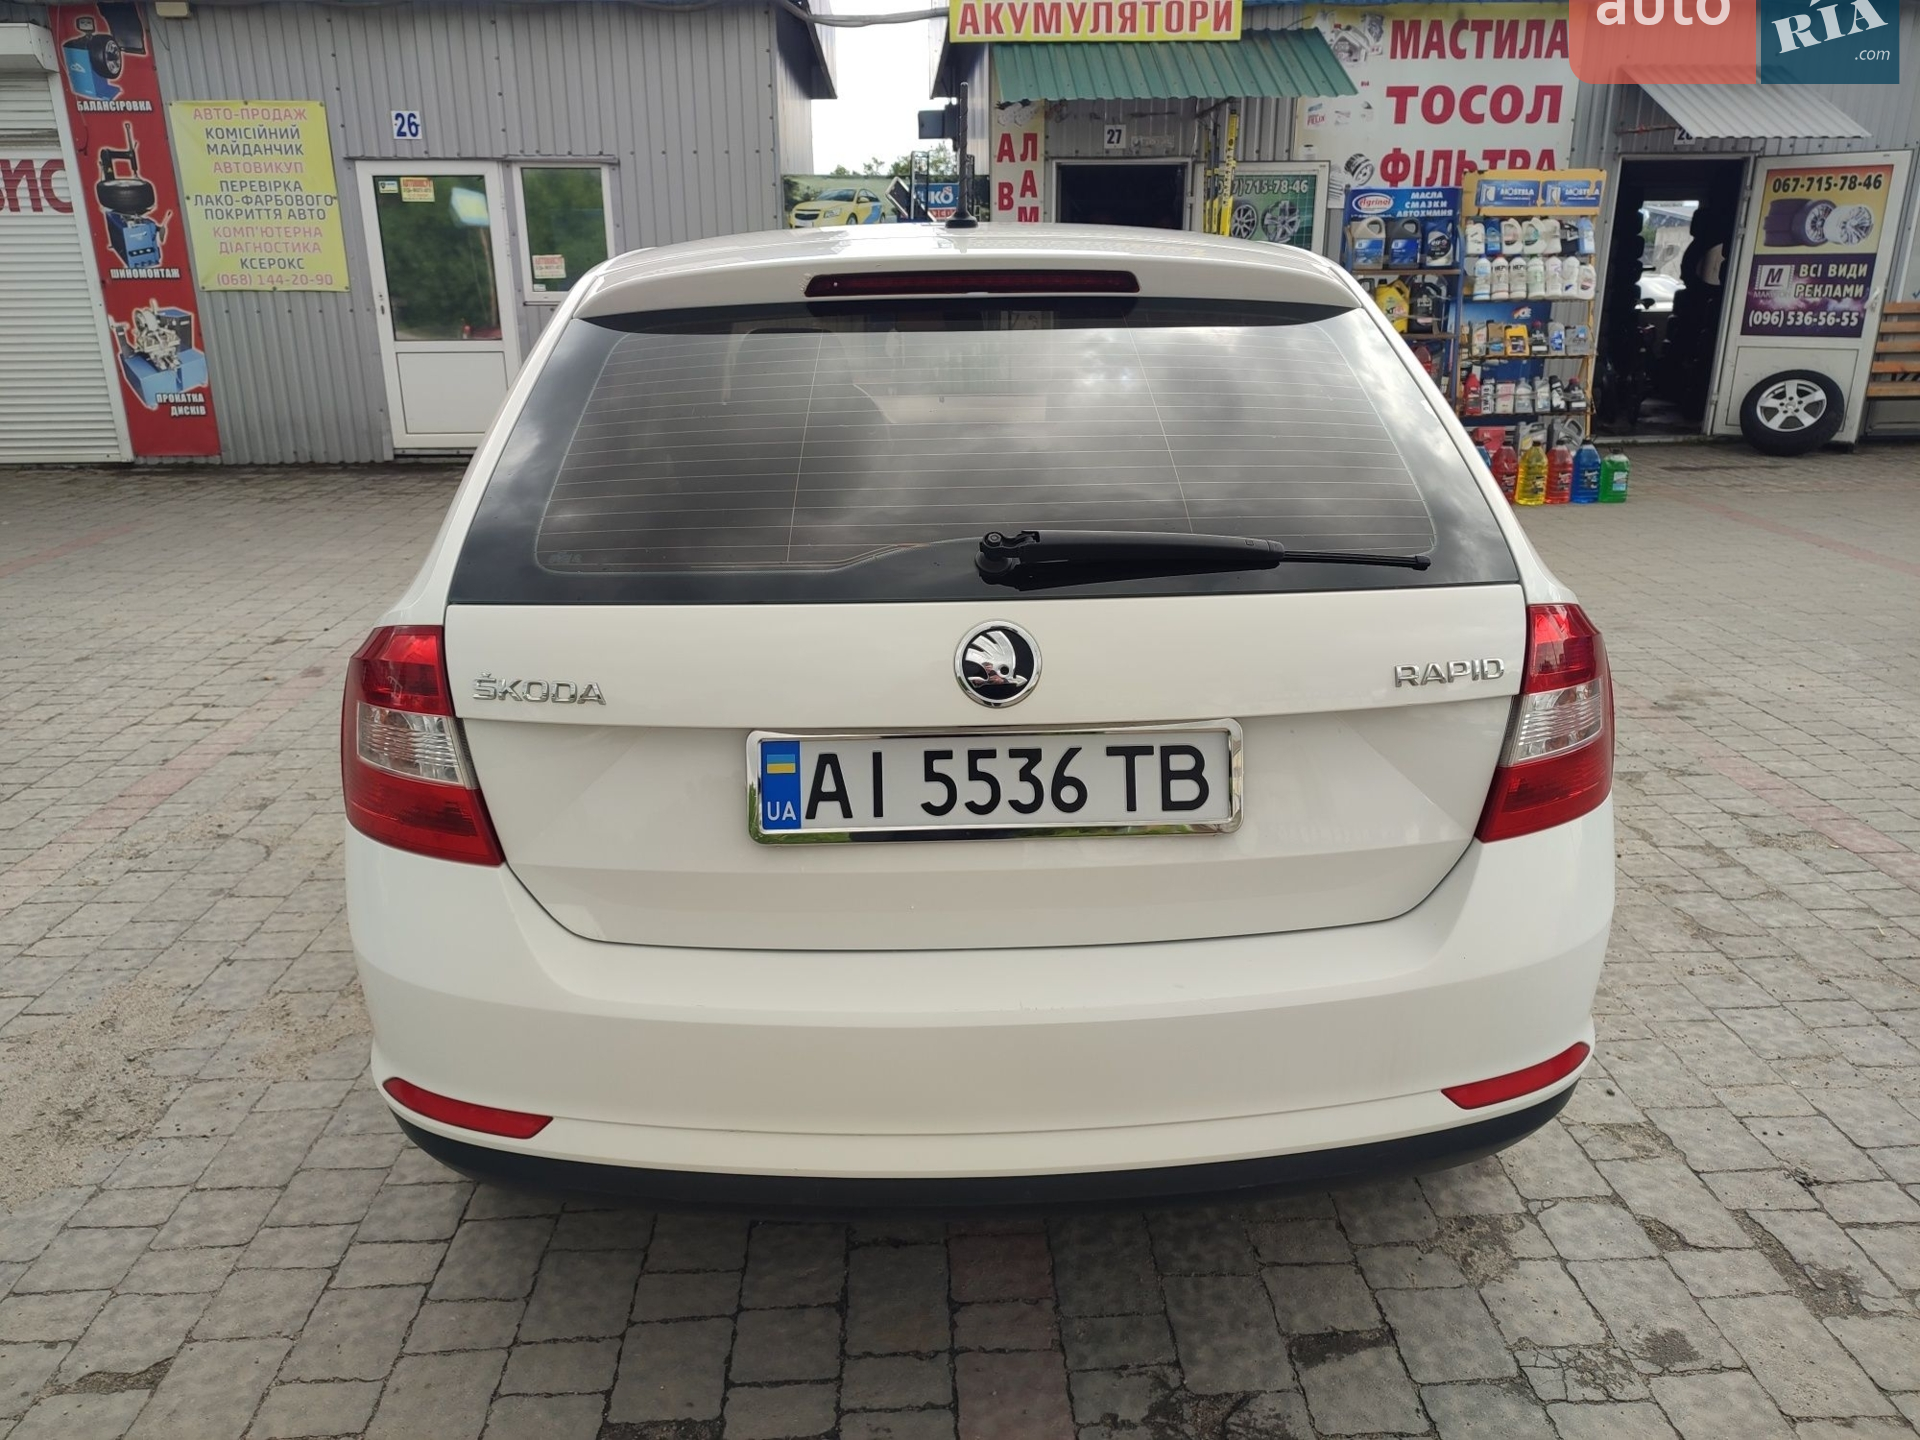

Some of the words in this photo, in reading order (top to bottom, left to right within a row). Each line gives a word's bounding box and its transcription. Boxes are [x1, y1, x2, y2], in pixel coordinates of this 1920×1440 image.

[958, 0, 1234, 35] АКУМУЛЯТОРИ
[1389, 19, 1569, 60] МАСТИЛА
[77, 100, 152, 112] БАЛАНСІРОВКА
[1386, 85, 1563, 125] ТОСОЛ
[193, 108, 307, 122] АВТО-ПРОДАЖ
[394, 112, 420, 137] 26
[205, 124, 301, 140] КОМІСІЙНИЙ
[1106, 129, 1122, 144] 27
[206, 141, 304, 156] МАЙДАНЧИК
[213, 161, 304, 174] АВТОВИКУП
[219, 180, 303, 193] ПЕРЕВІРКА
[1246, 180, 1309, 194] 715-78-46
[1772, 173, 1883, 193] 067-715-78-46
[194, 194, 334, 207] ЛАКО-ФАРБОВОГО
[1411, 191, 1444, 200] МАСЛА
[1404, 201, 1447, 209] СМАЗКИ
[204, 208, 282, 220] ПОКРИТТЯ
[287, 208, 326, 220] АВТО
[1396, 209, 1453, 218] АВТОХИМИЯ
[213, 226, 323, 238] КОМП'ЮТЕРНА
[219, 242, 322, 255] ДІАГНОСТИКА
[240, 258, 305, 270] КСЕРОКС
[1799, 263, 1822, 278] ВСІ
[1828, 263, 1868, 279] ВИДИ
[110, 268, 180, 280] ШИНОМОНТАЖ
[216, 274, 253, 287] (068)
[259, 274, 333, 286] 144-20-90
[1795, 284, 1864, 298] РЕКЛАМИ
[1749, 309, 1785, 328] (096)
[1787, 311, 1859, 326] 536-56-55
[156, 393, 205, 403] ПРОКАТКА
[171, 405, 206, 417] ДИСКІВ
[1394, 658, 1505, 688] RAPID
[472, 671, 606, 706] ŠKODA
[767, 799, 797, 821] UA
[805, 752, 884, 820] AI
[920, 746, 1089, 817] 5536
[1105, 743, 1210, 812] TB
